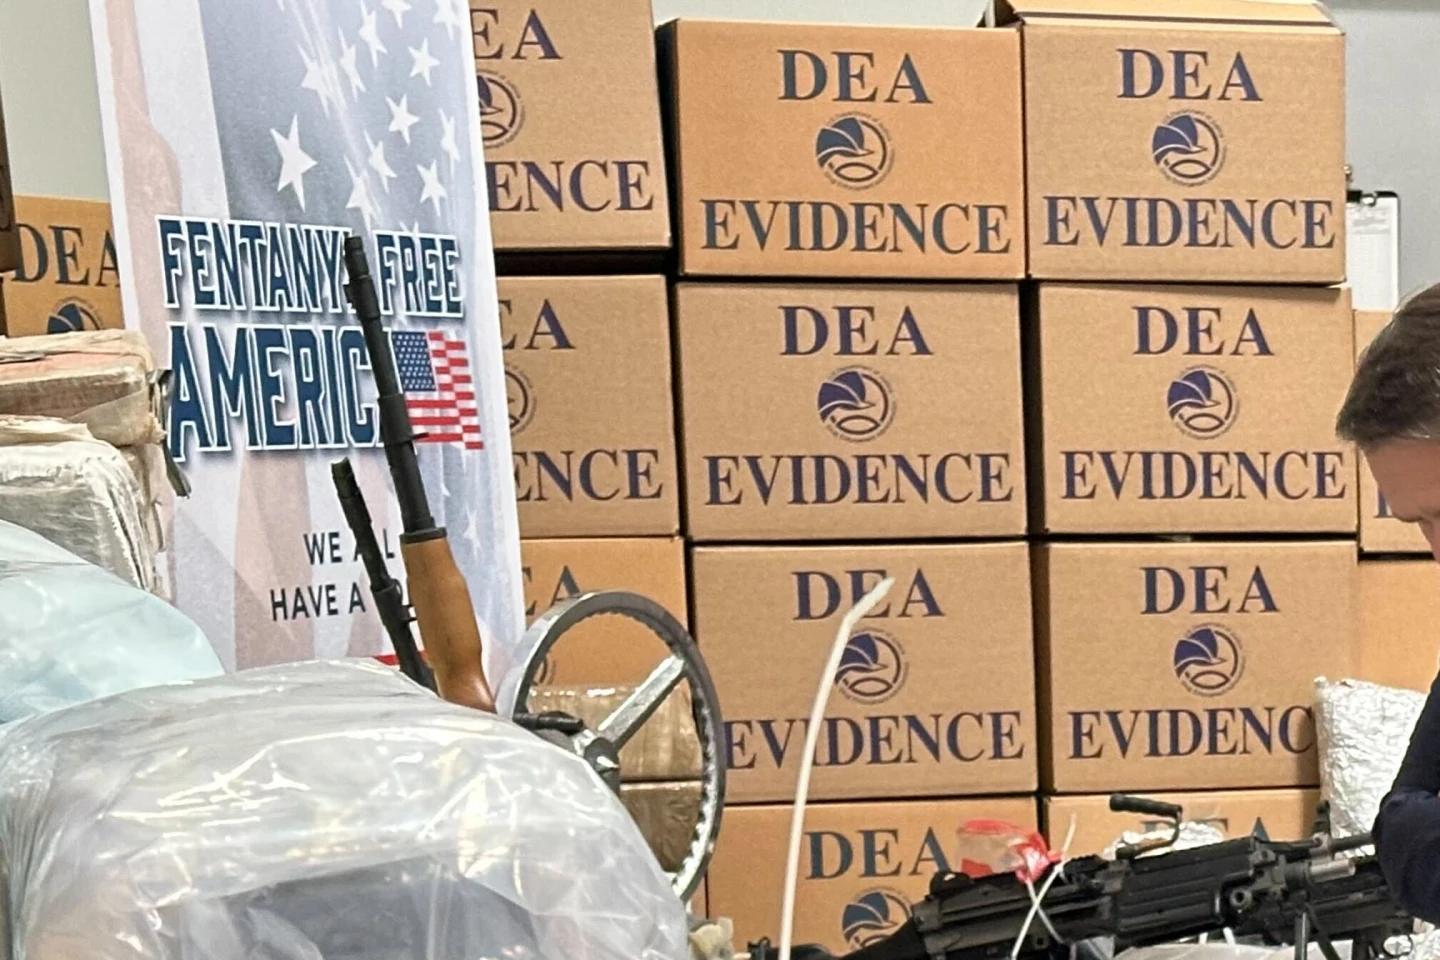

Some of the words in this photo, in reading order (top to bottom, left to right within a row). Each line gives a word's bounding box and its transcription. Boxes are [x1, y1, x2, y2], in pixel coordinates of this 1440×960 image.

[470, 8, 563, 60] EA
[777, 49, 932, 104] DEA
[1117, 49, 1263, 102] DEA
[484, 159, 654, 212] ENCE
[702, 200, 1011, 255] EVIDENCE
[1043, 195, 1336, 250] EVIDENCE
[11, 223, 120, 288] DEA
[155, 214, 357, 316] FENTANY
[373, 229, 464, 318] FREE
[778, 305, 933, 357] DEA
[1133, 306, 1274, 357] DEA
[165, 321, 404, 464] AMERIC
[704, 453, 1014, 506] EVIDENCE
[1061, 449, 1346, 501] EVIDENCE
[303, 531, 342, 566] WE
[270, 584, 339, 622] HAVE
[348, 581, 367, 614] A
[791, 568, 945, 621] DEA
[1141, 564, 1278, 616] DEA
[723, 711, 1024, 770] EVIDENCE
[1069, 704, 1312, 760] EVIDENC
[803, 825, 954, 881] DEA
